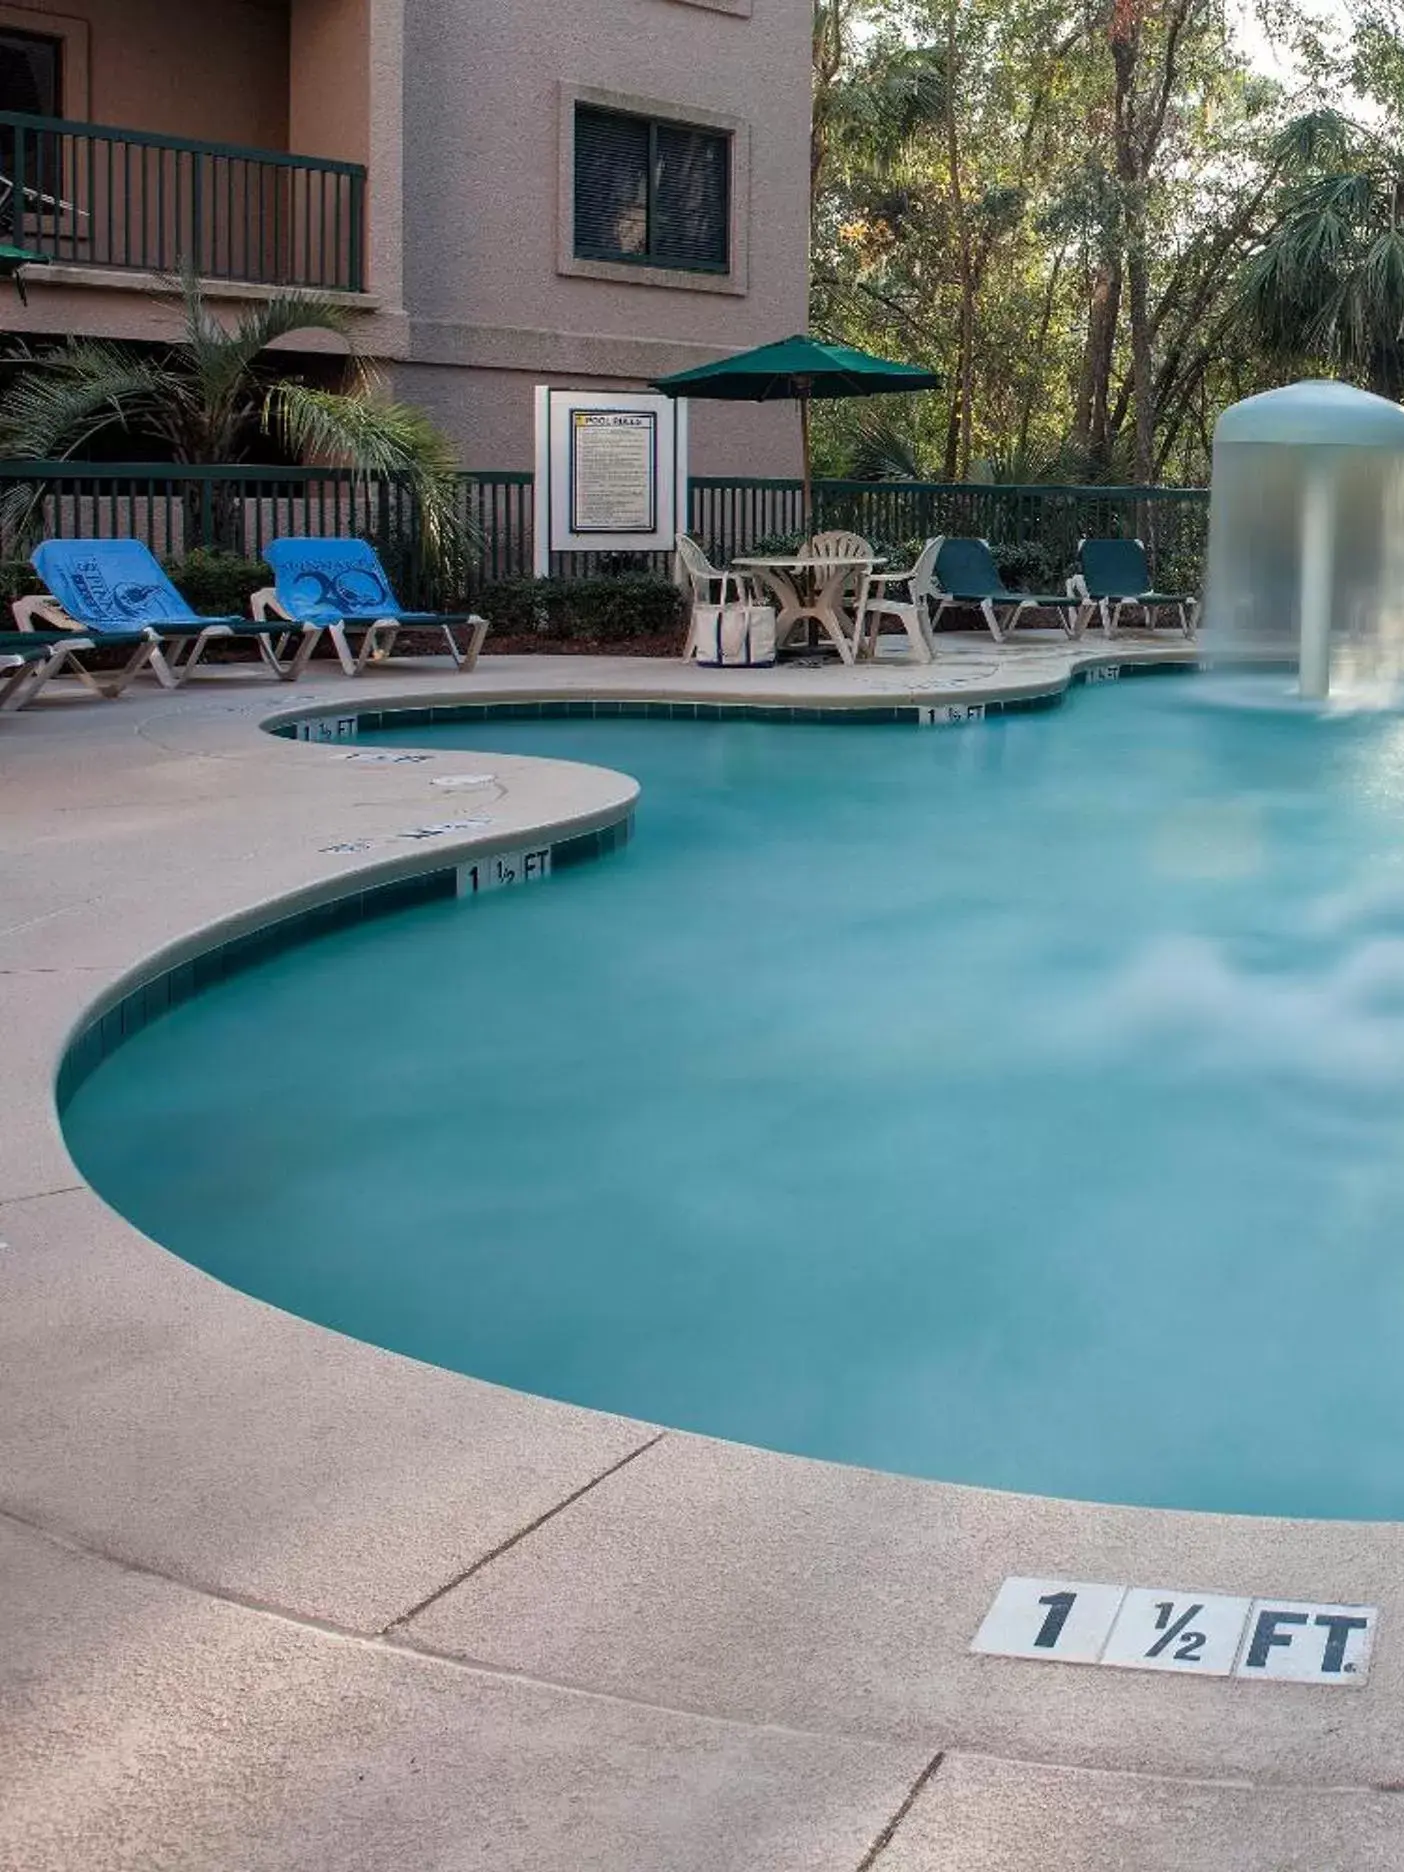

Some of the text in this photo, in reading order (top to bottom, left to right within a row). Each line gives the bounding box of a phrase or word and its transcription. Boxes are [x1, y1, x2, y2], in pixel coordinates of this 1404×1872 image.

[338, 718, 355, 737] FT
[469, 866, 478, 892] 1
[524, 849, 549, 881] FT
[1034, 1592, 1077, 1648] 1
